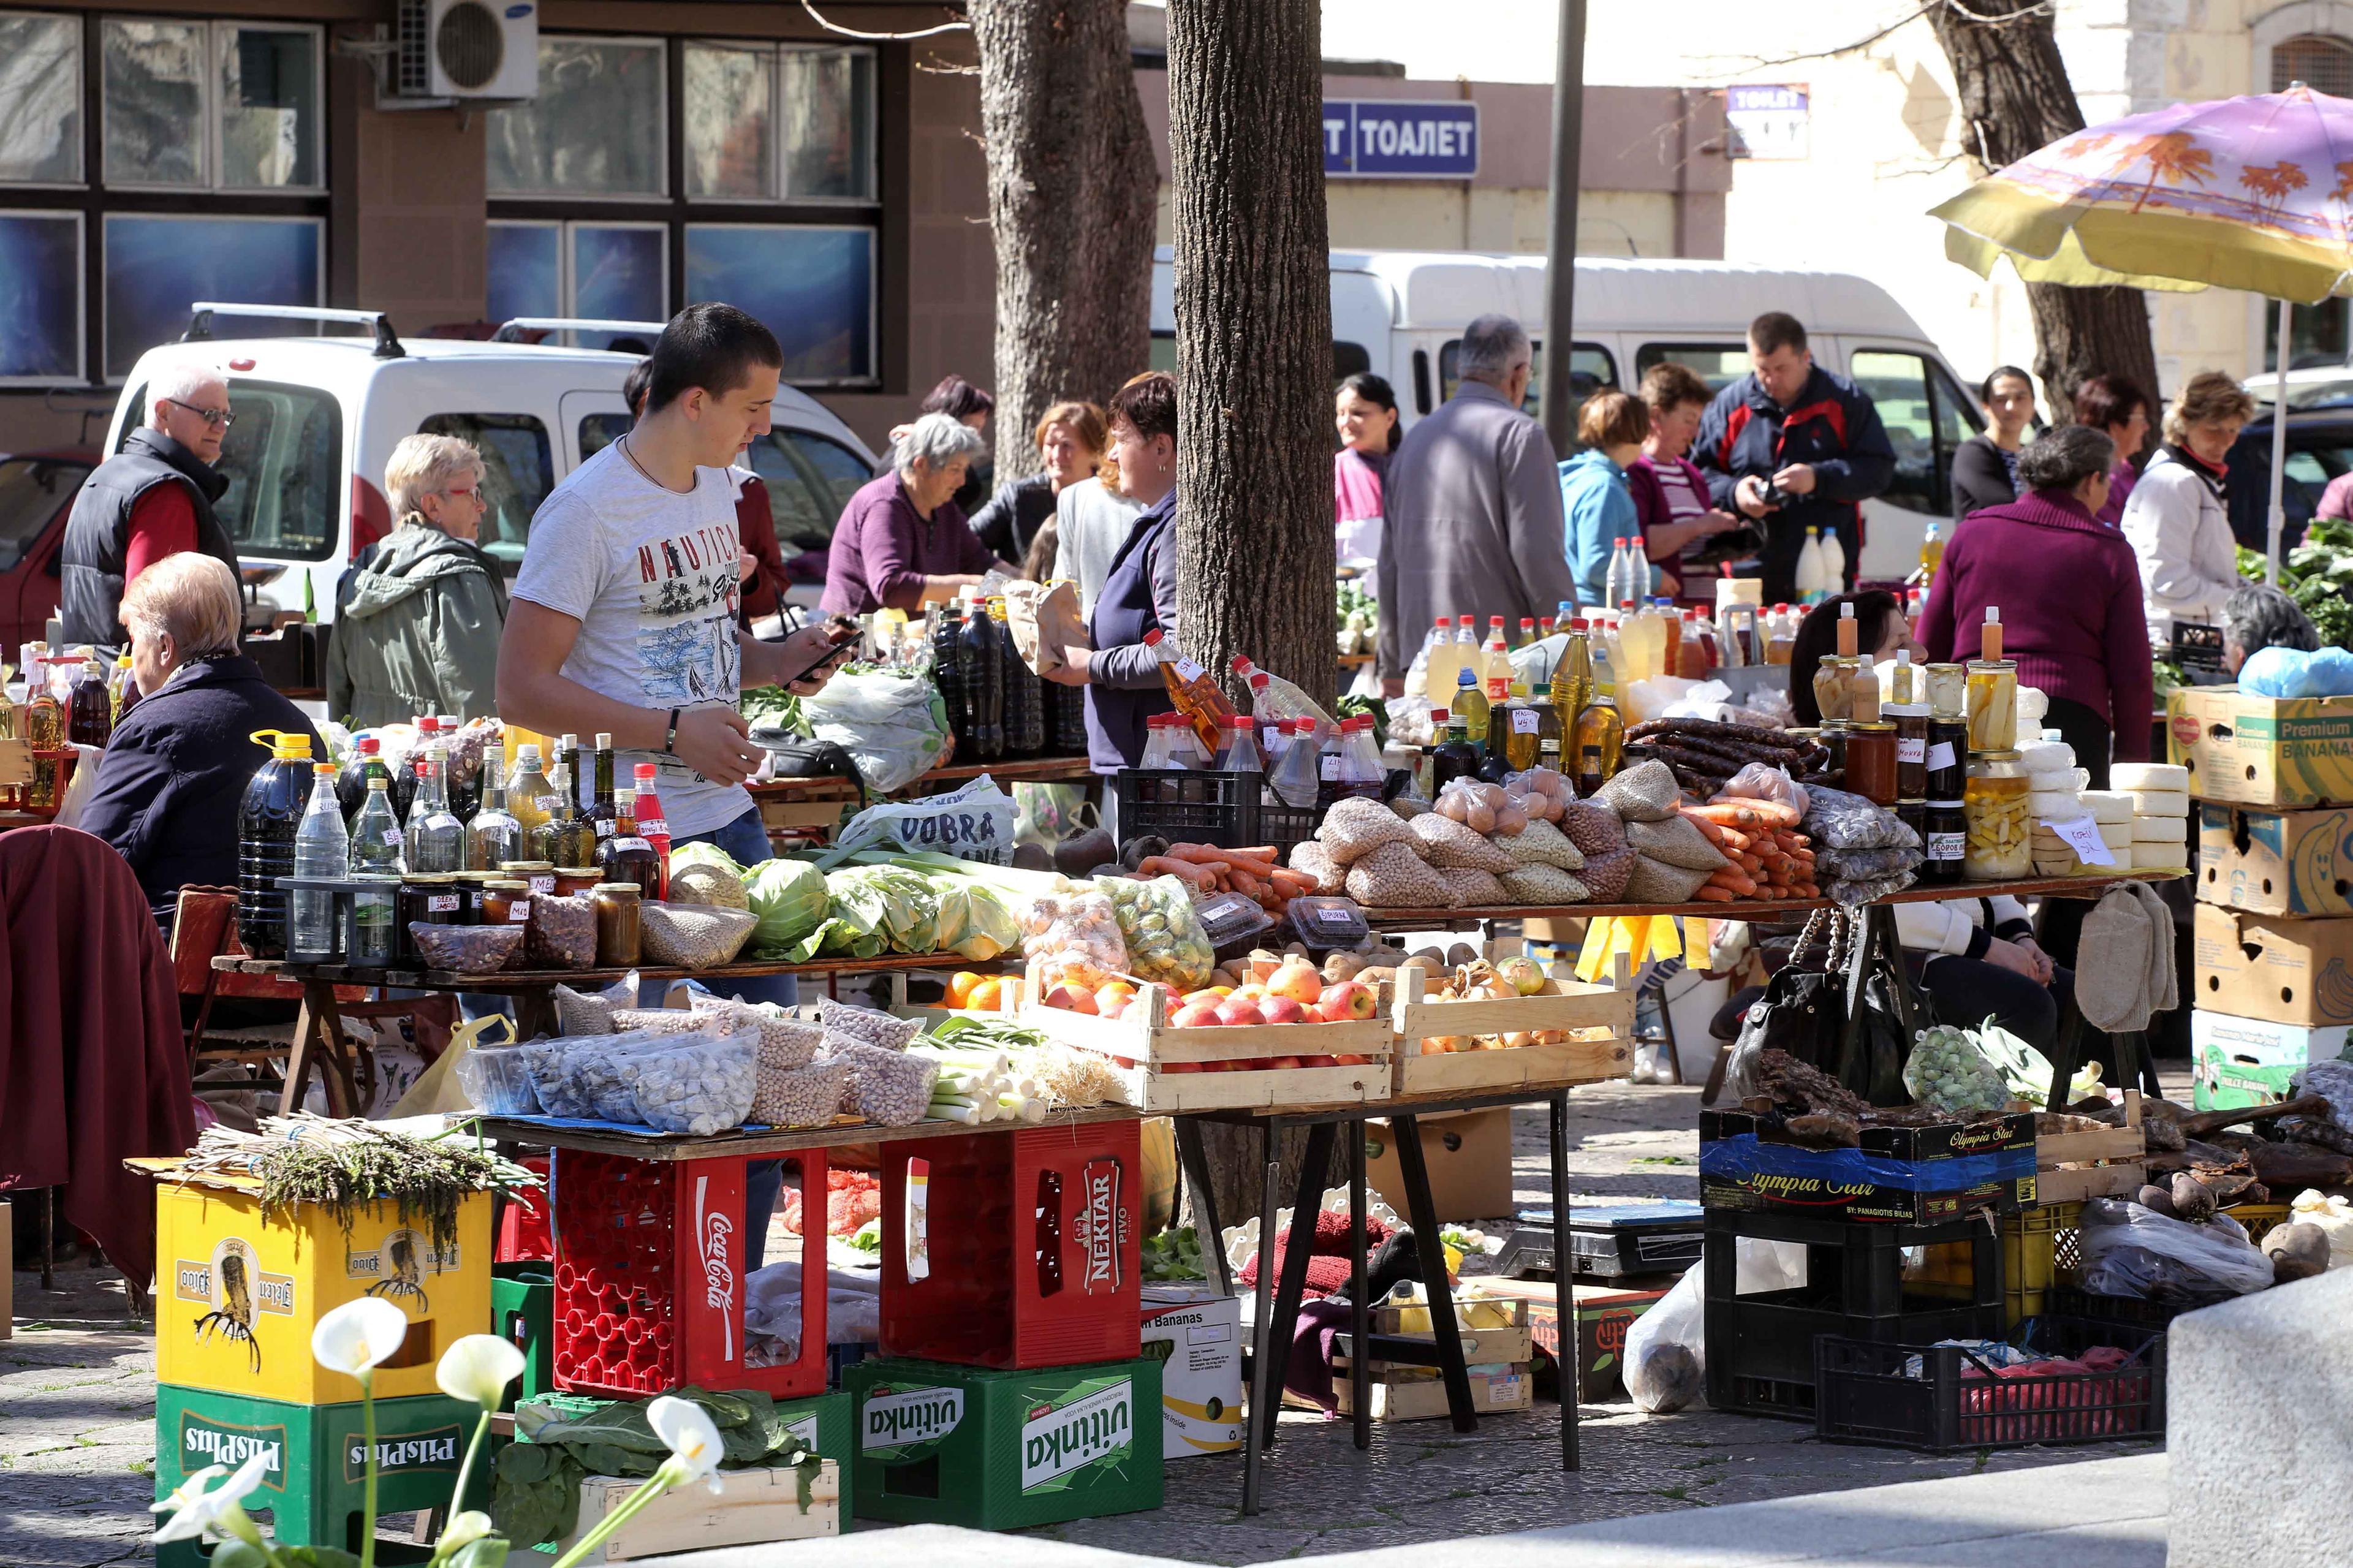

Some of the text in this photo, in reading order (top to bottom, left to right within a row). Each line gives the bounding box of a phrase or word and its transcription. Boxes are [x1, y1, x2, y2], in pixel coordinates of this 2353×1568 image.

[1359, 119, 1473, 157] ТОАЛЕТ
[2282, 722, 2350, 738] Premium
[1950, 1125, 2013, 1149] Olympia Star
[1091, 1173, 1110, 1282] NEKTAR
[1118, 1207, 1127, 1244] PIVO
[1857, 1207, 1893, 1218] PANAGIOTIS
[707, 1211, 733, 1311] Coca-Cola
[181, 1268, 292, 1308] Jelen Pivo
[1154, 1312, 1203, 1328] Bananas
[1170, 1415, 1186, 1430] inside
